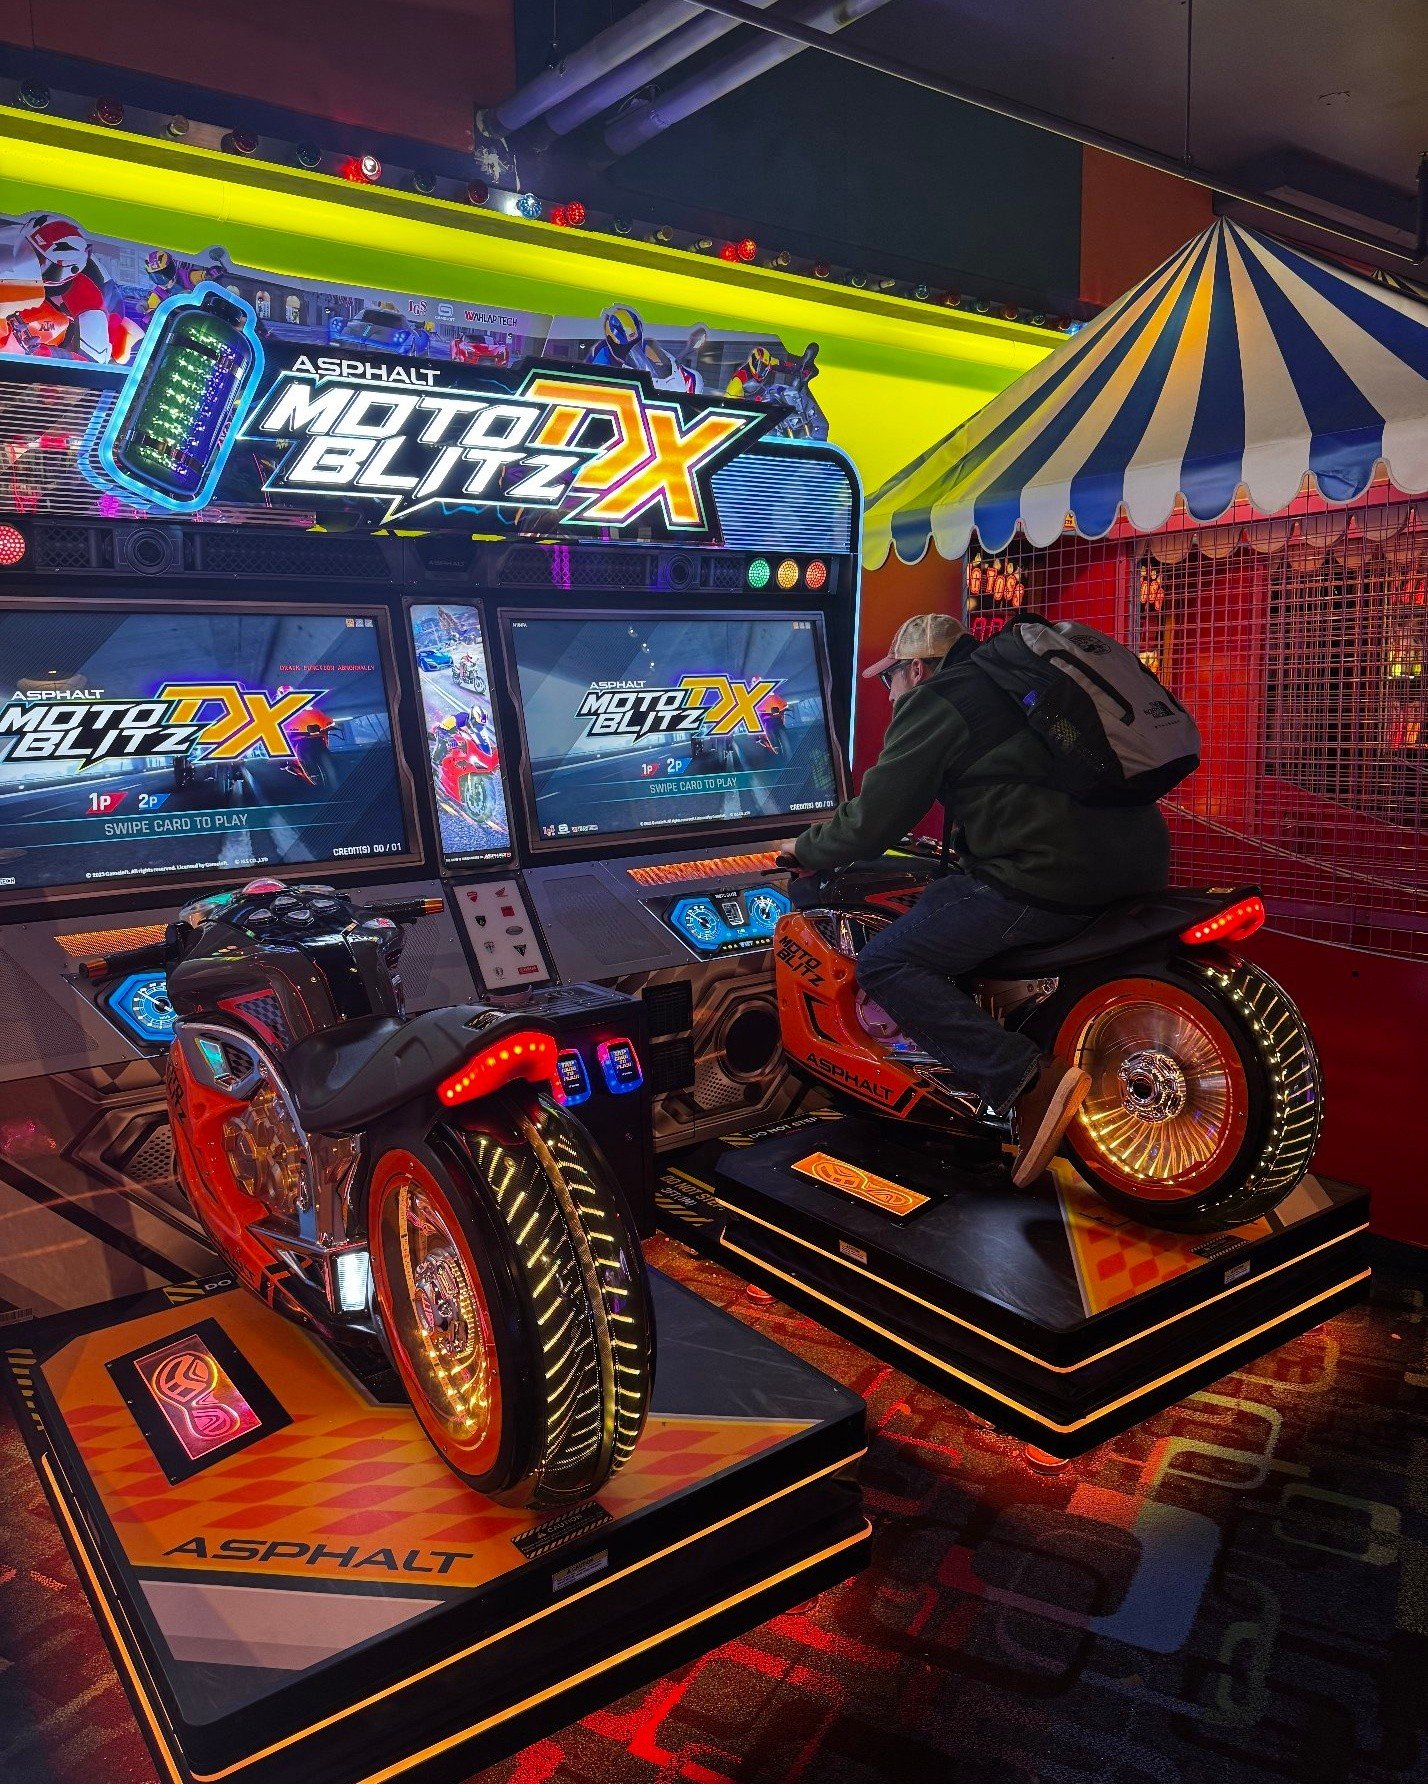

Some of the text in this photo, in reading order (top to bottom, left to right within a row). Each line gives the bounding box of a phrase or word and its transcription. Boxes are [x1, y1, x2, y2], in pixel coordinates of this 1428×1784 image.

[408, 299, 427, 316] IGS
[498, 315, 518, 327] TECH
[291, 356, 441, 386] ASPHALT
[259, 376, 749, 524] MOTO DX
[287, 434, 580, 500] BLITZ
[11, 689, 104, 700] ASPHALT
[590, 681, 646, 690] ASPHALT
[581, 676, 777, 735] MOTO DX
[0, 686, 316, 758] MOTO DX
[593, 709, 708, 736] BLITZ
[12, 727, 198, 759] BLITZ
[641, 763, 653, 775] 1P
[666, 758, 682, 773] 2P
[649, 777, 737, 794] SWIPE CARD TO PLAY
[89, 792, 112, 811] 1P
[138, 793, 158, 808] 2P
[104, 813, 248, 836] SWIPE CARD TO PLAY
[333, 844, 371, 856] CREDIT(S)
[373, 844, 385, 853] 00
[391, 842, 402, 851] 01
[778, 935, 823, 970] MOTO
[775, 947, 826, 988] BLITZ
[805, 1052, 895, 1101] ASPHALT
[748, 1131, 767, 1139] DO
[767, 1124, 791, 1134] NOT
[660, 1175, 681, 1184] DO
[674, 1182, 702, 1195] NOT
[204, 1279, 232, 1290] DO
[547, 1513, 583, 1533] CAUTION
[162, 1536, 474, 1574] ASPHALT
